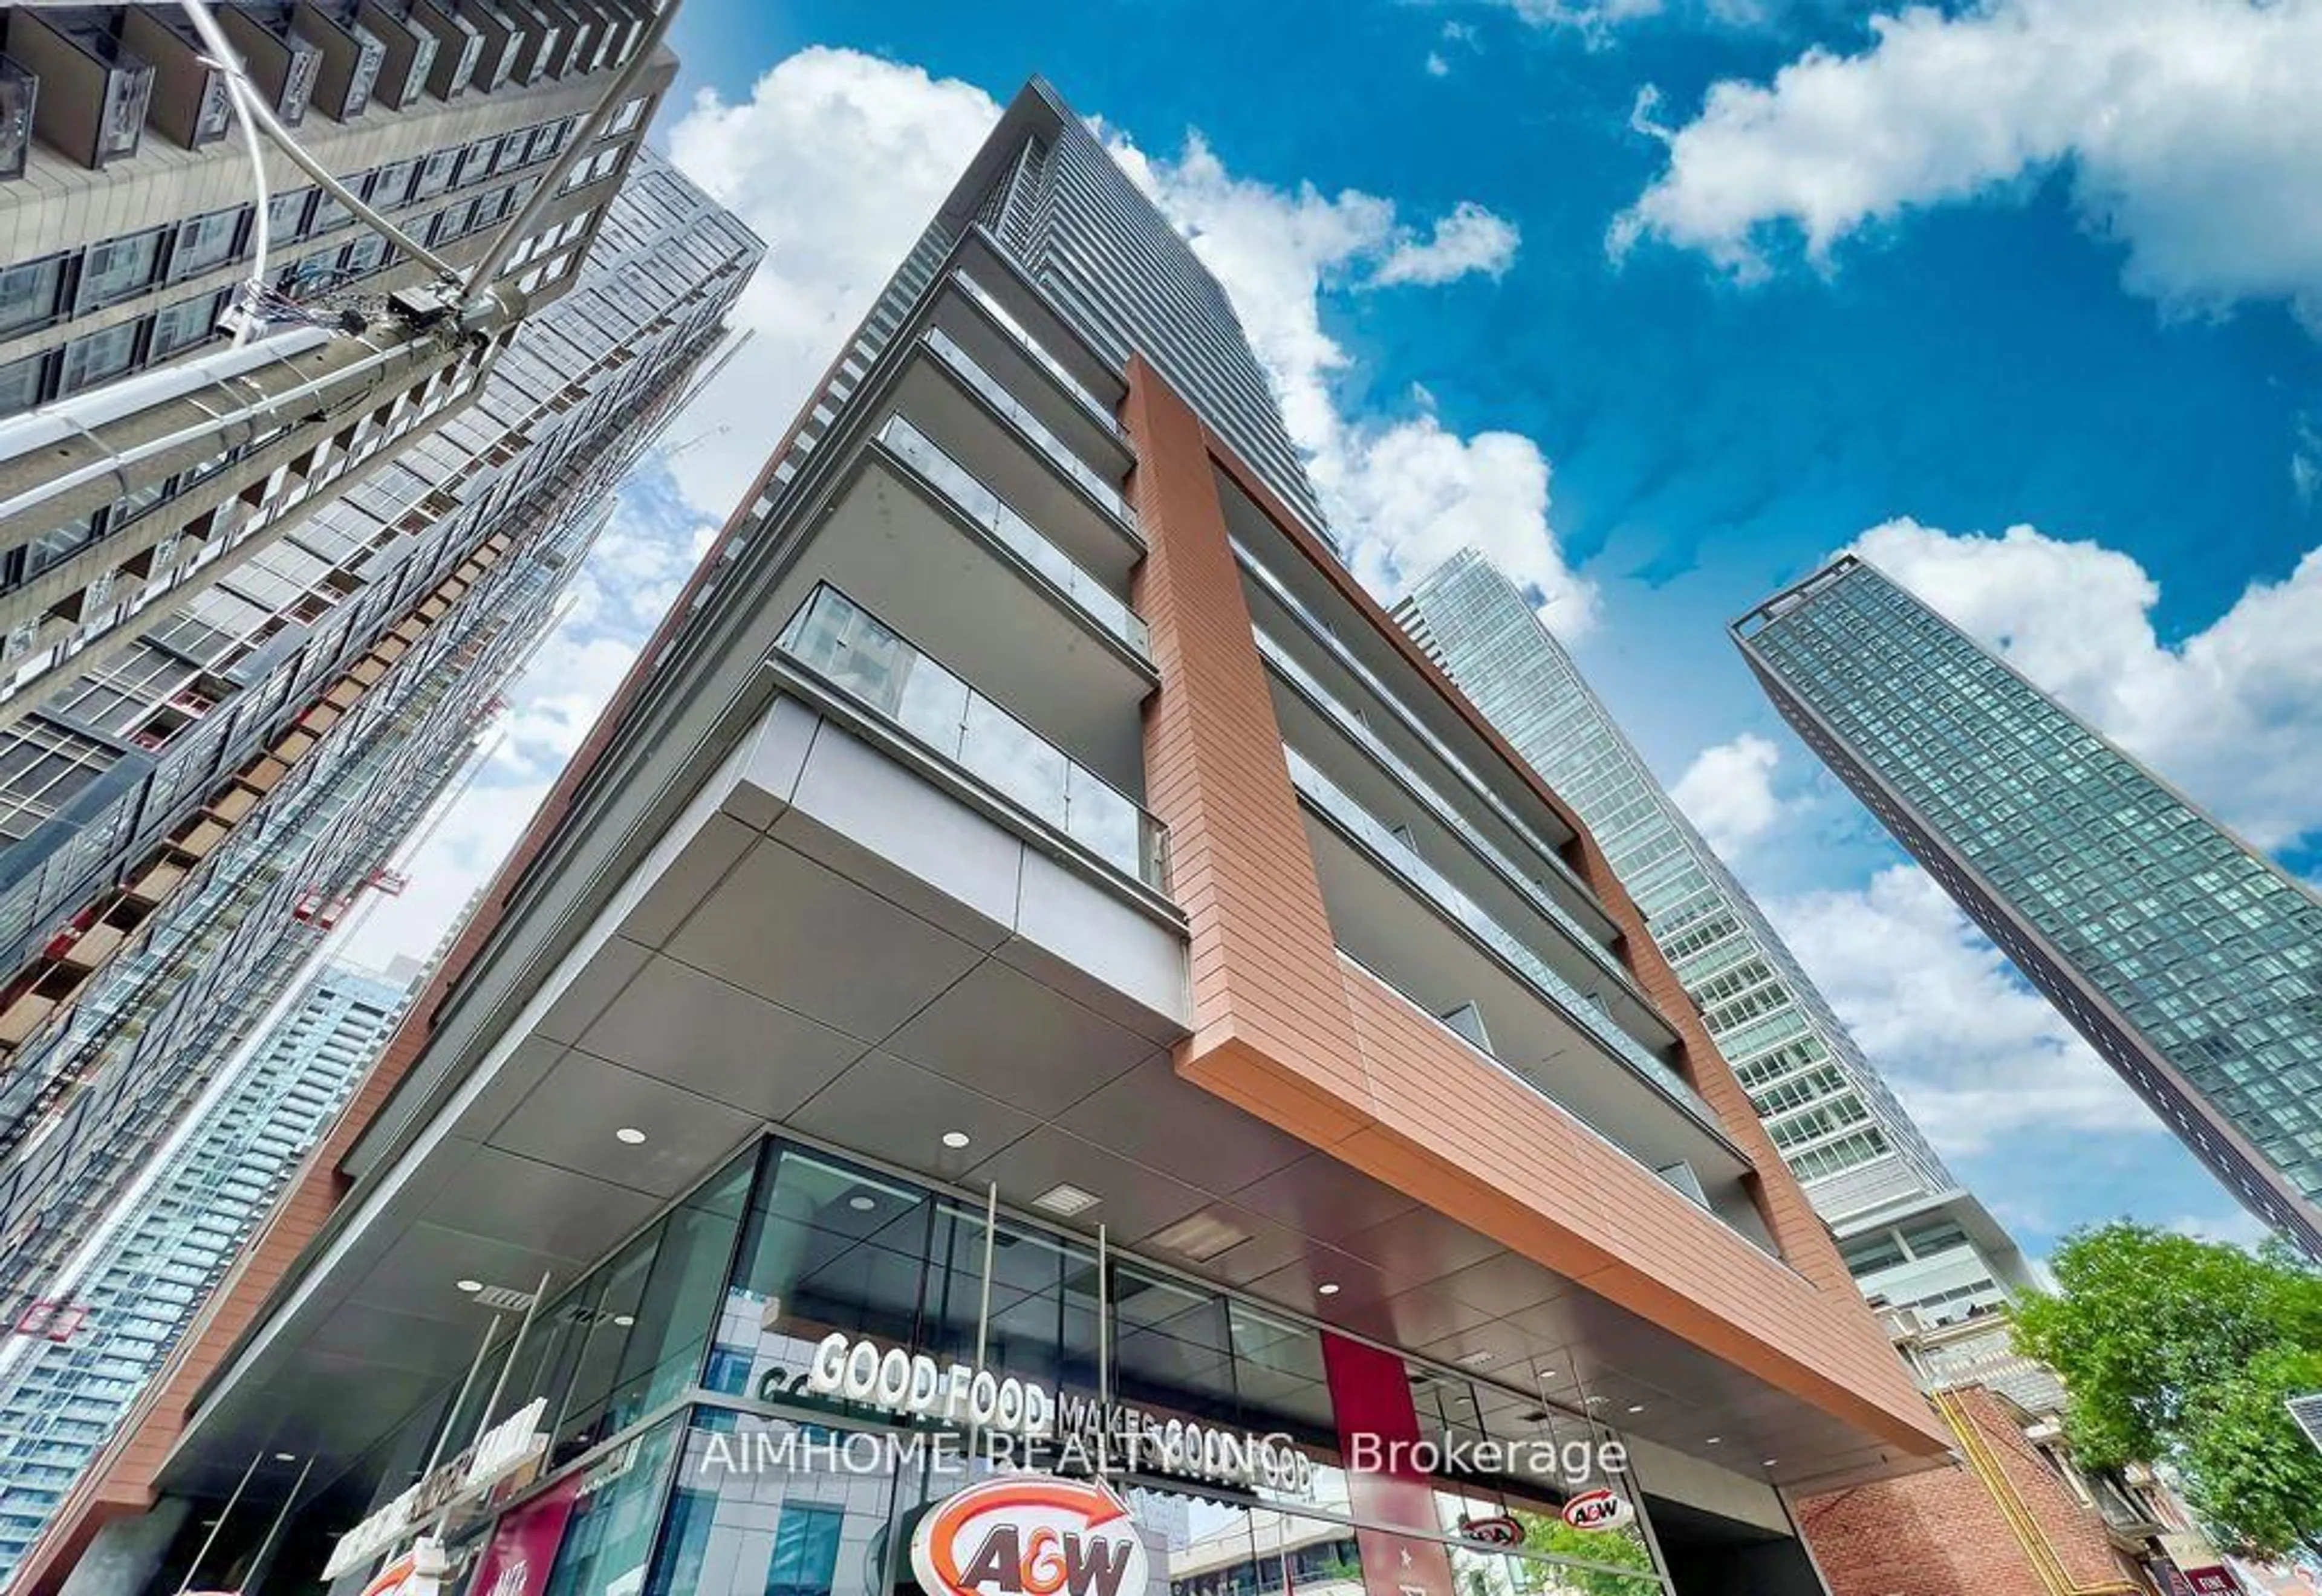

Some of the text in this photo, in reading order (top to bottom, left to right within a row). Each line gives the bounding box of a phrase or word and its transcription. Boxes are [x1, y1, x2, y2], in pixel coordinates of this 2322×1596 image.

[808, 1332, 938, 1412] GOOD
[942, 1364, 1047, 1432] FOOD
[1058, 1391, 1157, 1459] MAKES
[958, 1523, 1135, 1596] A&W
